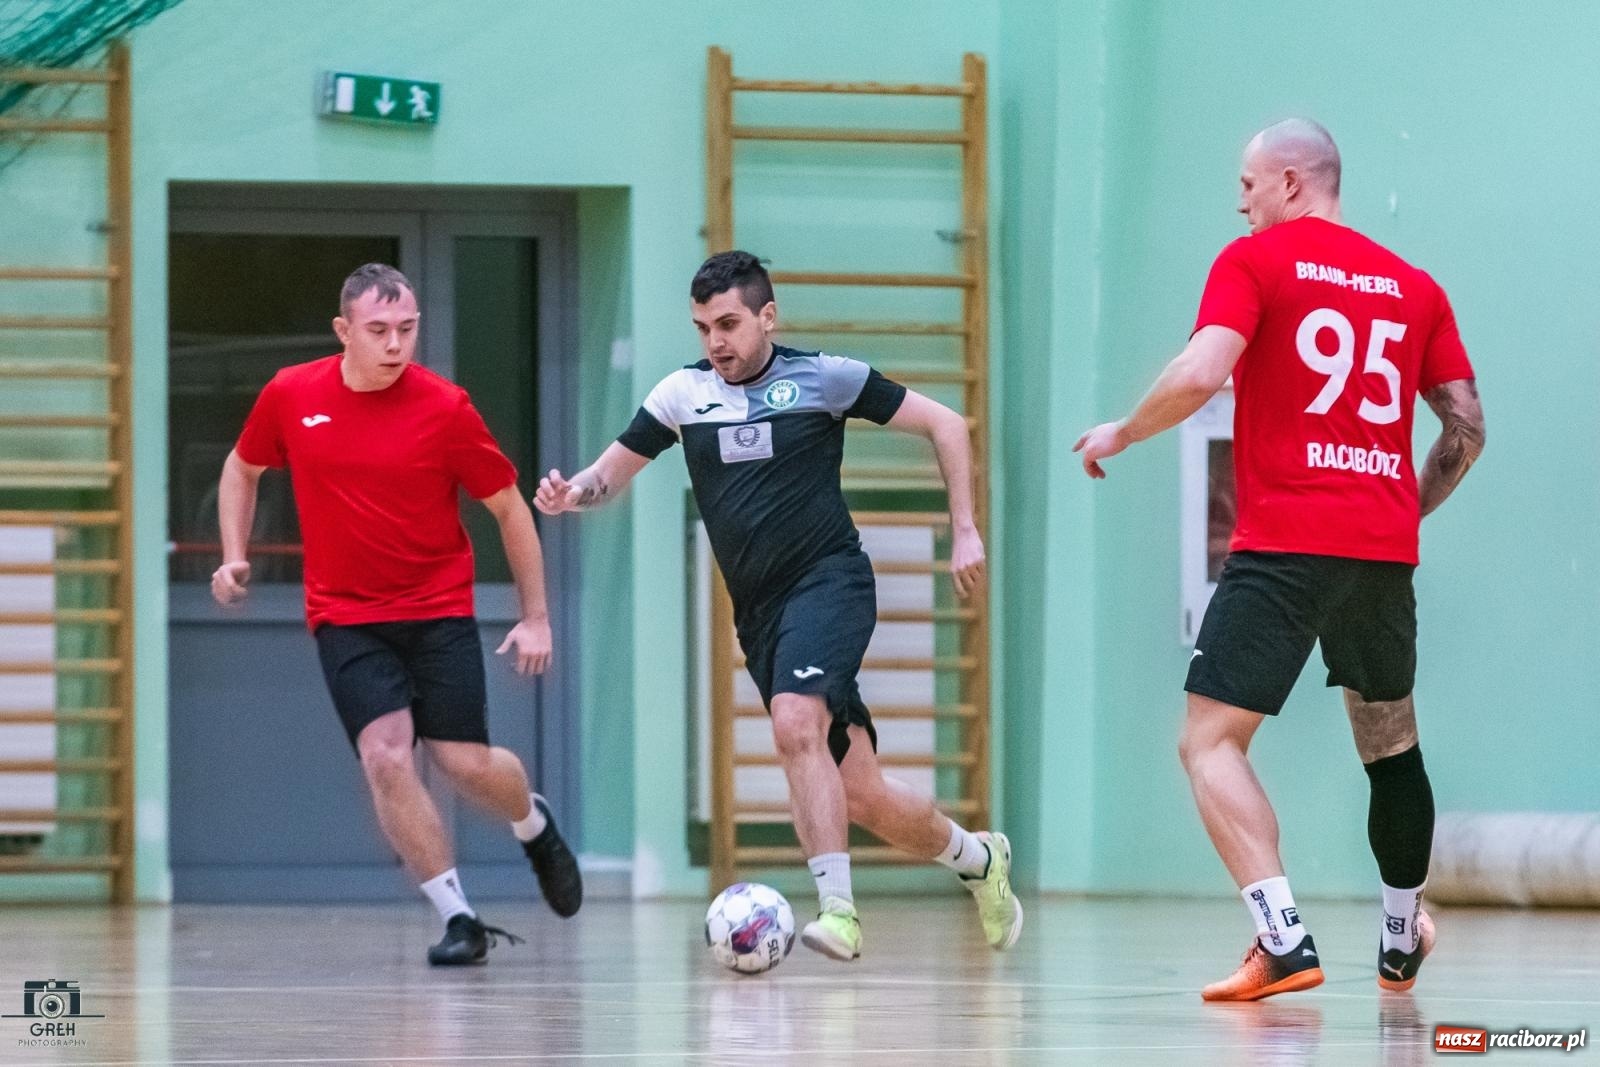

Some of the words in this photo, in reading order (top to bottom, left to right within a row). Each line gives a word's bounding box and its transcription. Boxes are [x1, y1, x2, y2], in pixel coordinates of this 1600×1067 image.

[1296, 261, 1403, 299] BRAUN-MEBEL
[1295, 308, 1408, 425] 95
[1307, 442, 1402, 480] RACIBÓRZ
